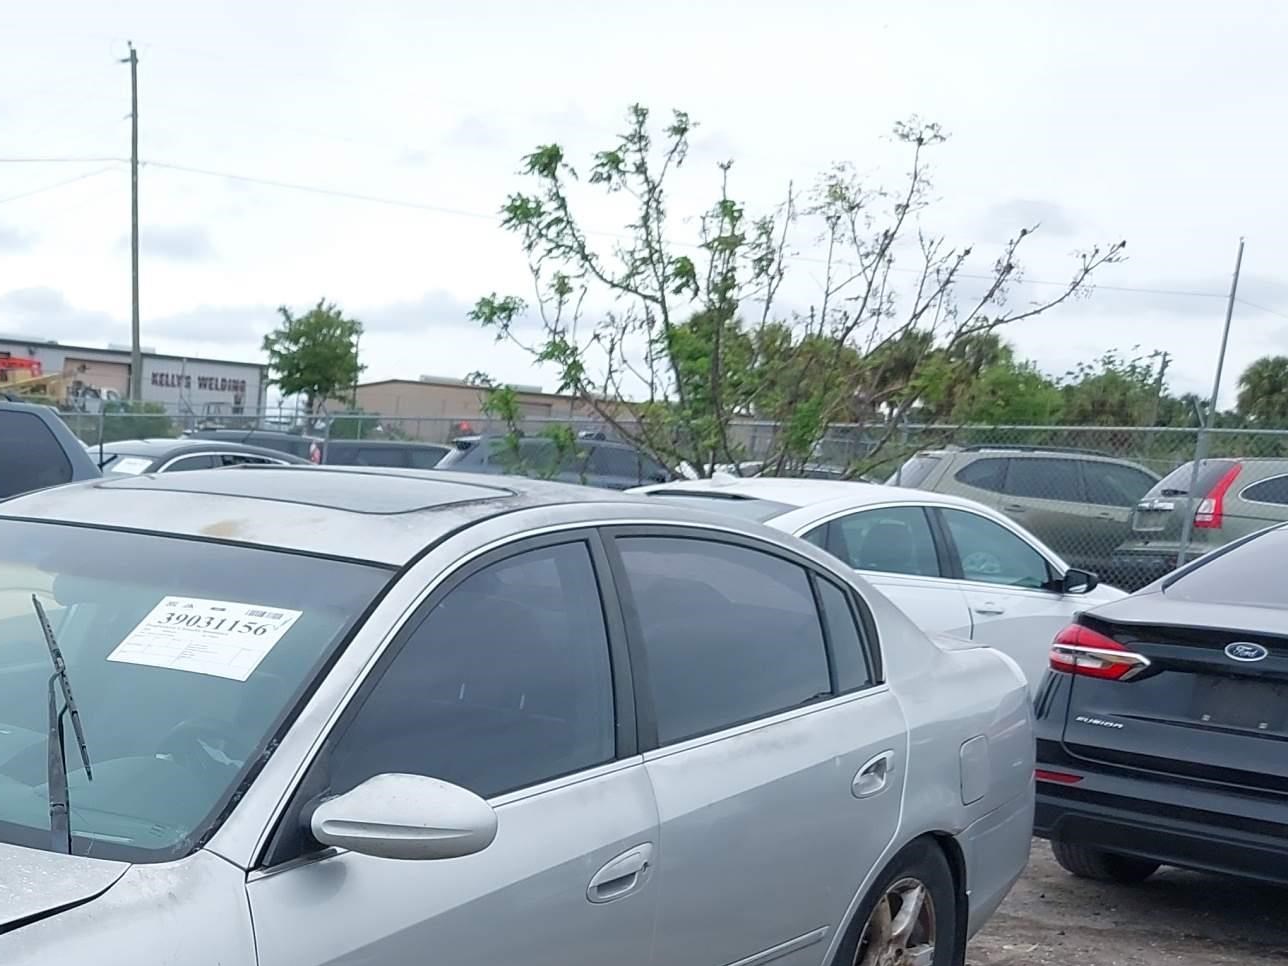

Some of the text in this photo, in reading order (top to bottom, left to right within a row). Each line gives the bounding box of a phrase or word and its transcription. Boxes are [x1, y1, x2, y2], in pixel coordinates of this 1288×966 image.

[197, 375, 247, 393] WELDING
[158, 611, 267, 637] 39031156
[1232, 645, 1258, 657] Ford
[1075, 716, 1124, 729] FUSION
